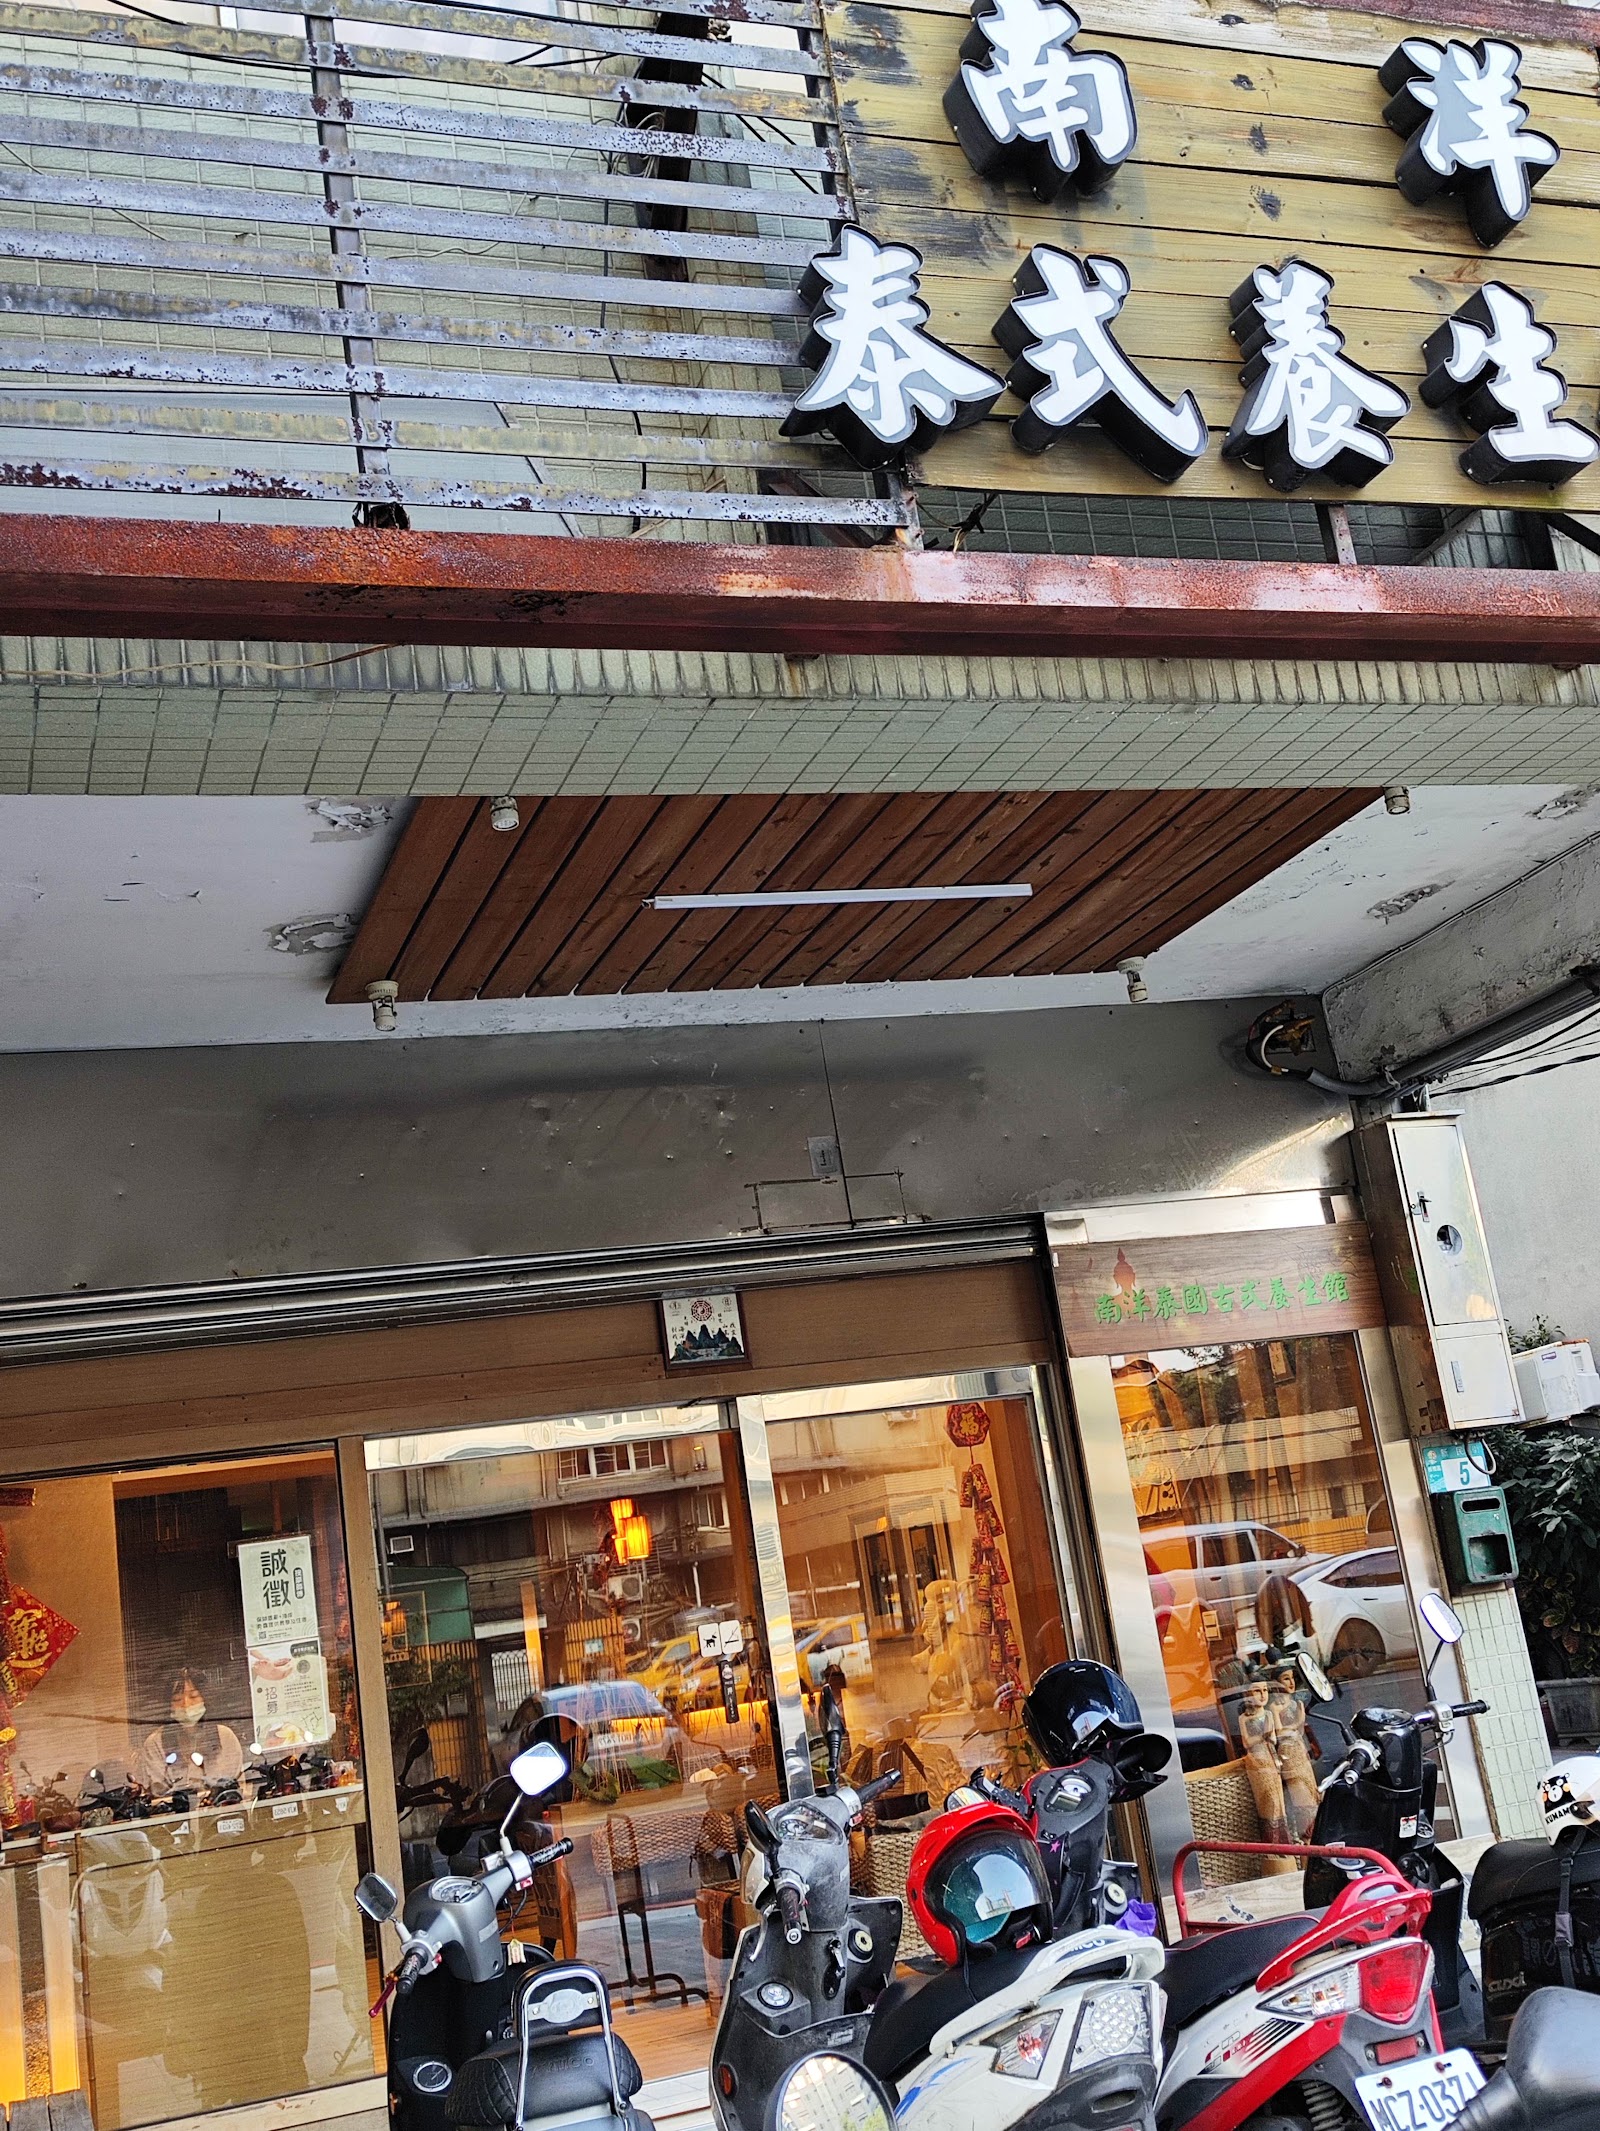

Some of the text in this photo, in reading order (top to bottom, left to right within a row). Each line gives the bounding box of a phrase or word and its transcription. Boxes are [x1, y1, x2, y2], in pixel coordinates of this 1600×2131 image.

[794, 224, 1600, 470] 泰式養生
[1094, 1271, 1350, 1325] 南洋泰國古式養生館
[1460, 1461, 1471, 1486] 5
[260, 1548, 291, 1610] 誠徵
[265, 1687, 278, 1715] 招募
